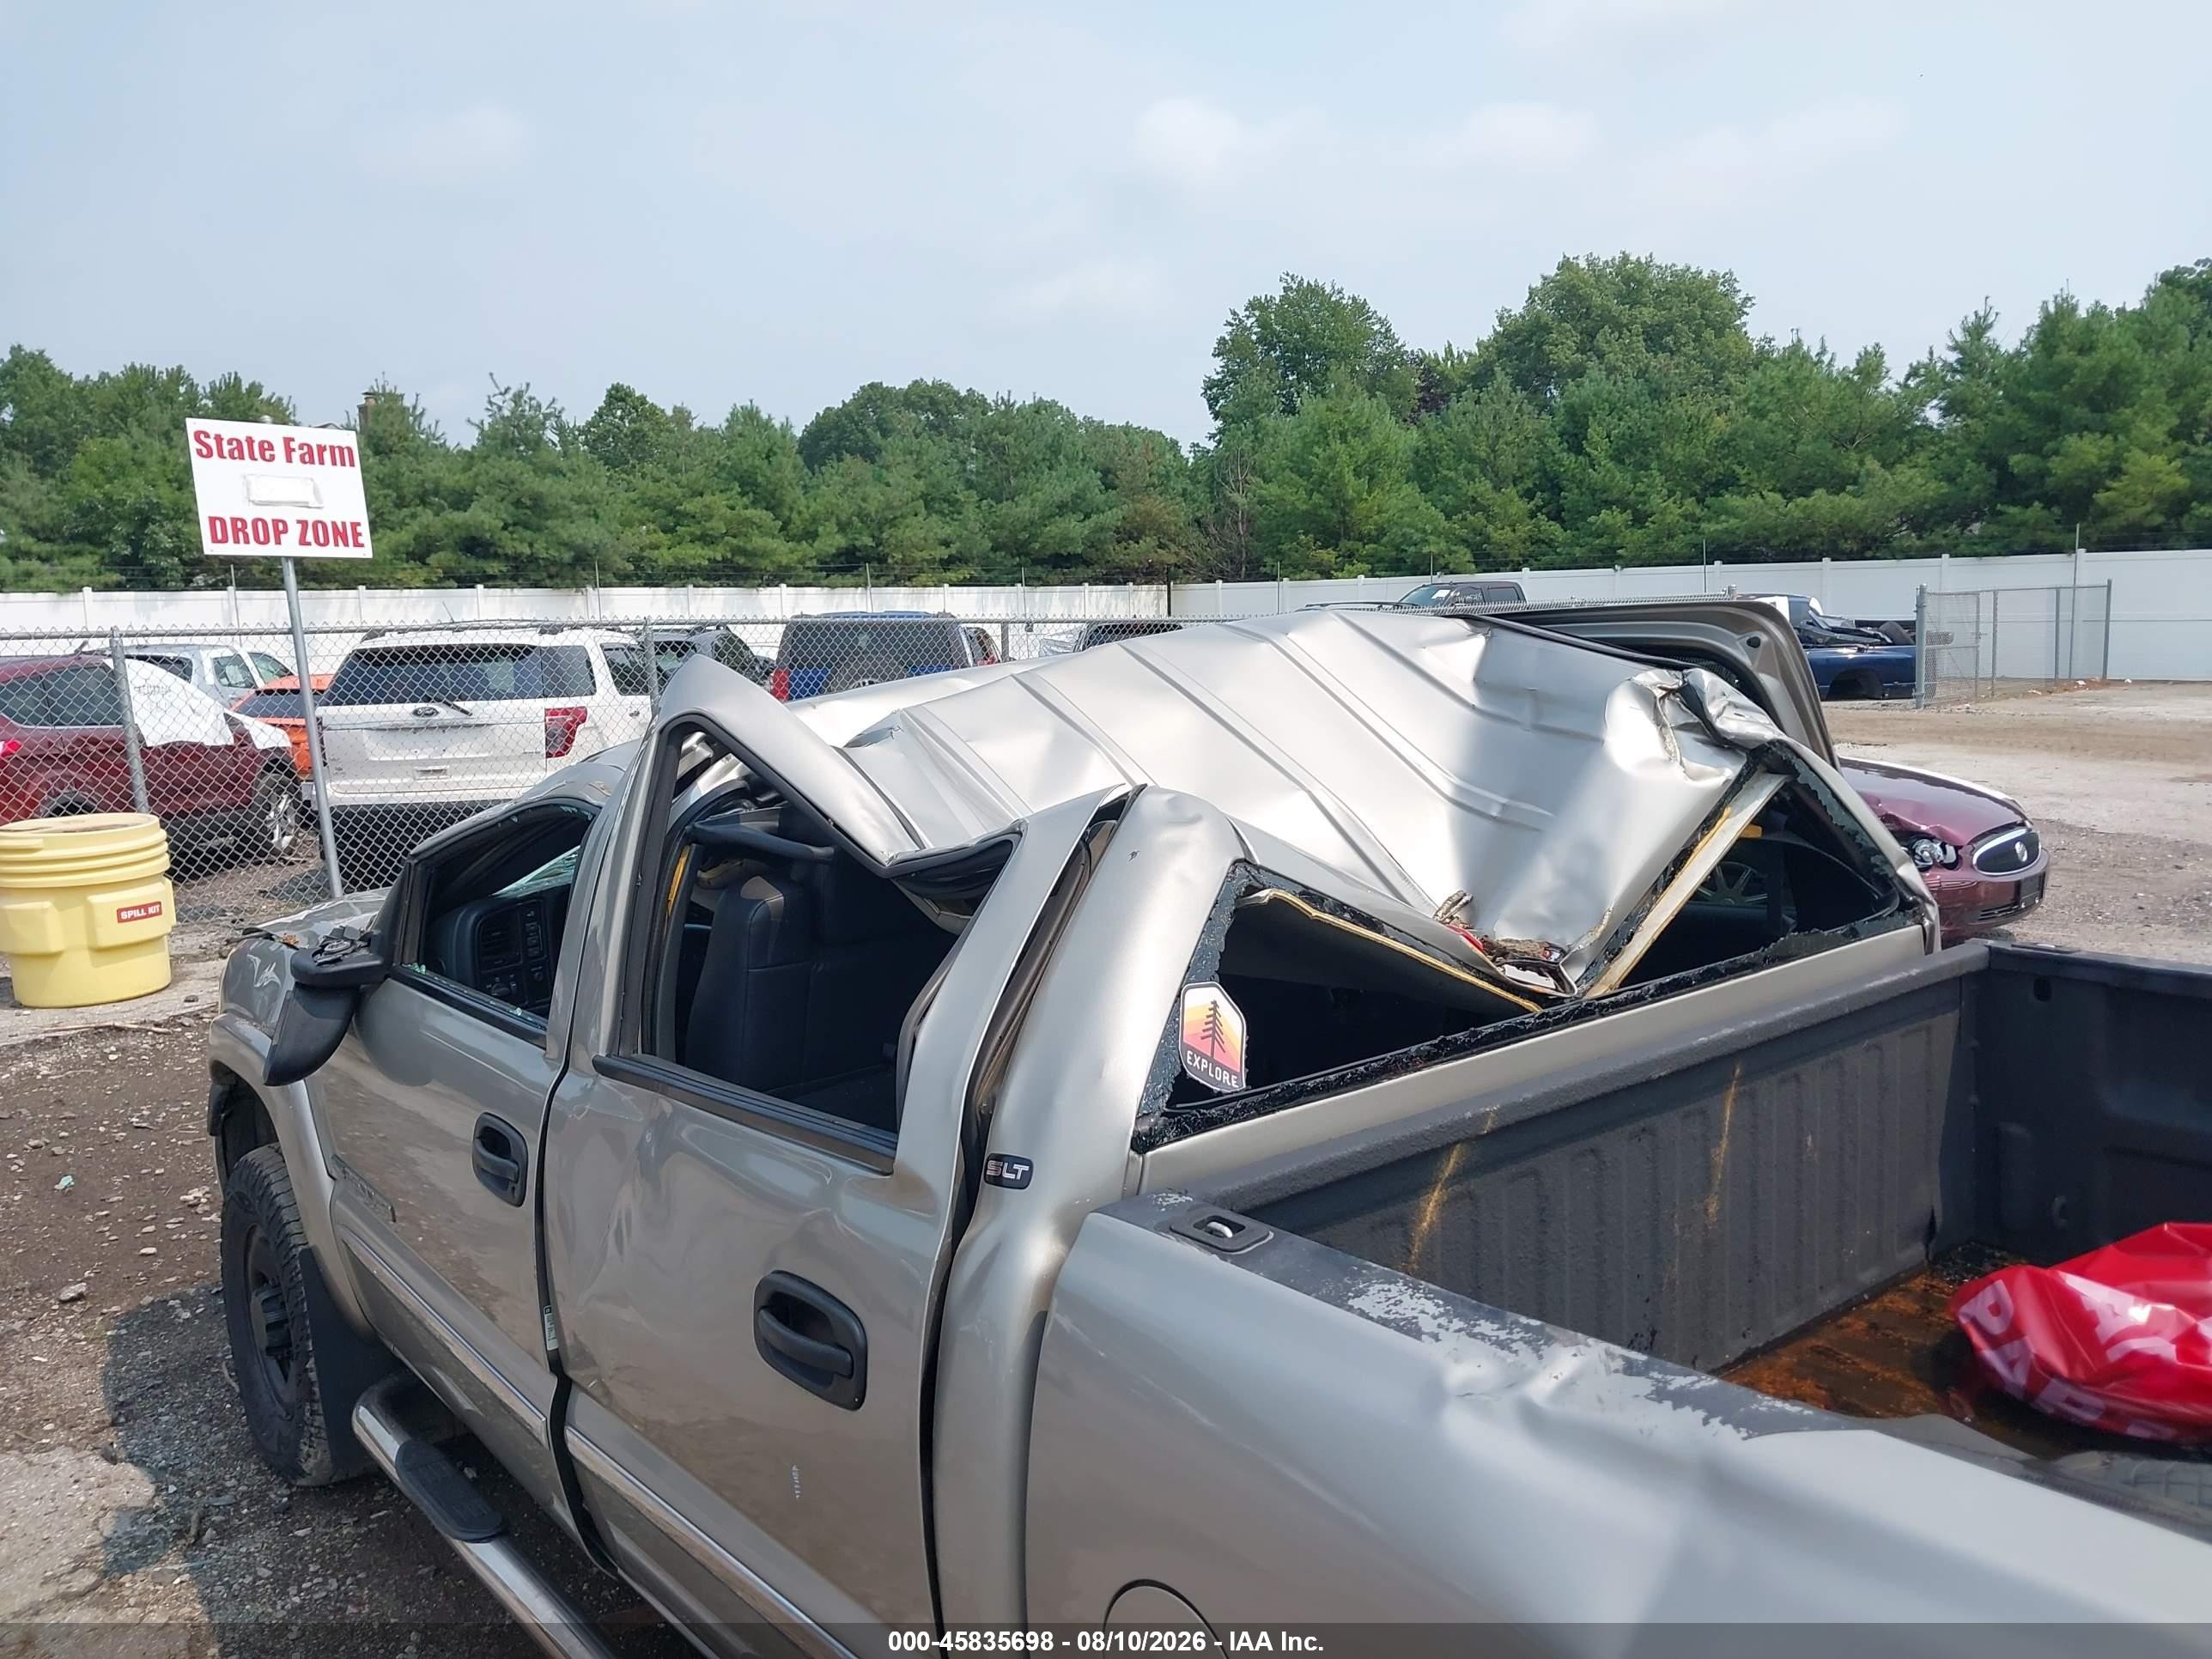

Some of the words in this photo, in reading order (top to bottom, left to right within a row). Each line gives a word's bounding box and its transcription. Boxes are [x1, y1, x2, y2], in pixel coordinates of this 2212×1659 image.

[193, 430, 276, 462] State
[283, 436, 356, 467] Farm
[208, 516, 289, 545] DROP
[296, 520, 365, 549] ZONE
[120, 908, 147, 920] SPILL
[148, 904, 161, 915] KIT
[1186, 1050, 1239, 1088] EXPLORE
[986, 1160, 1030, 1180] SLT
